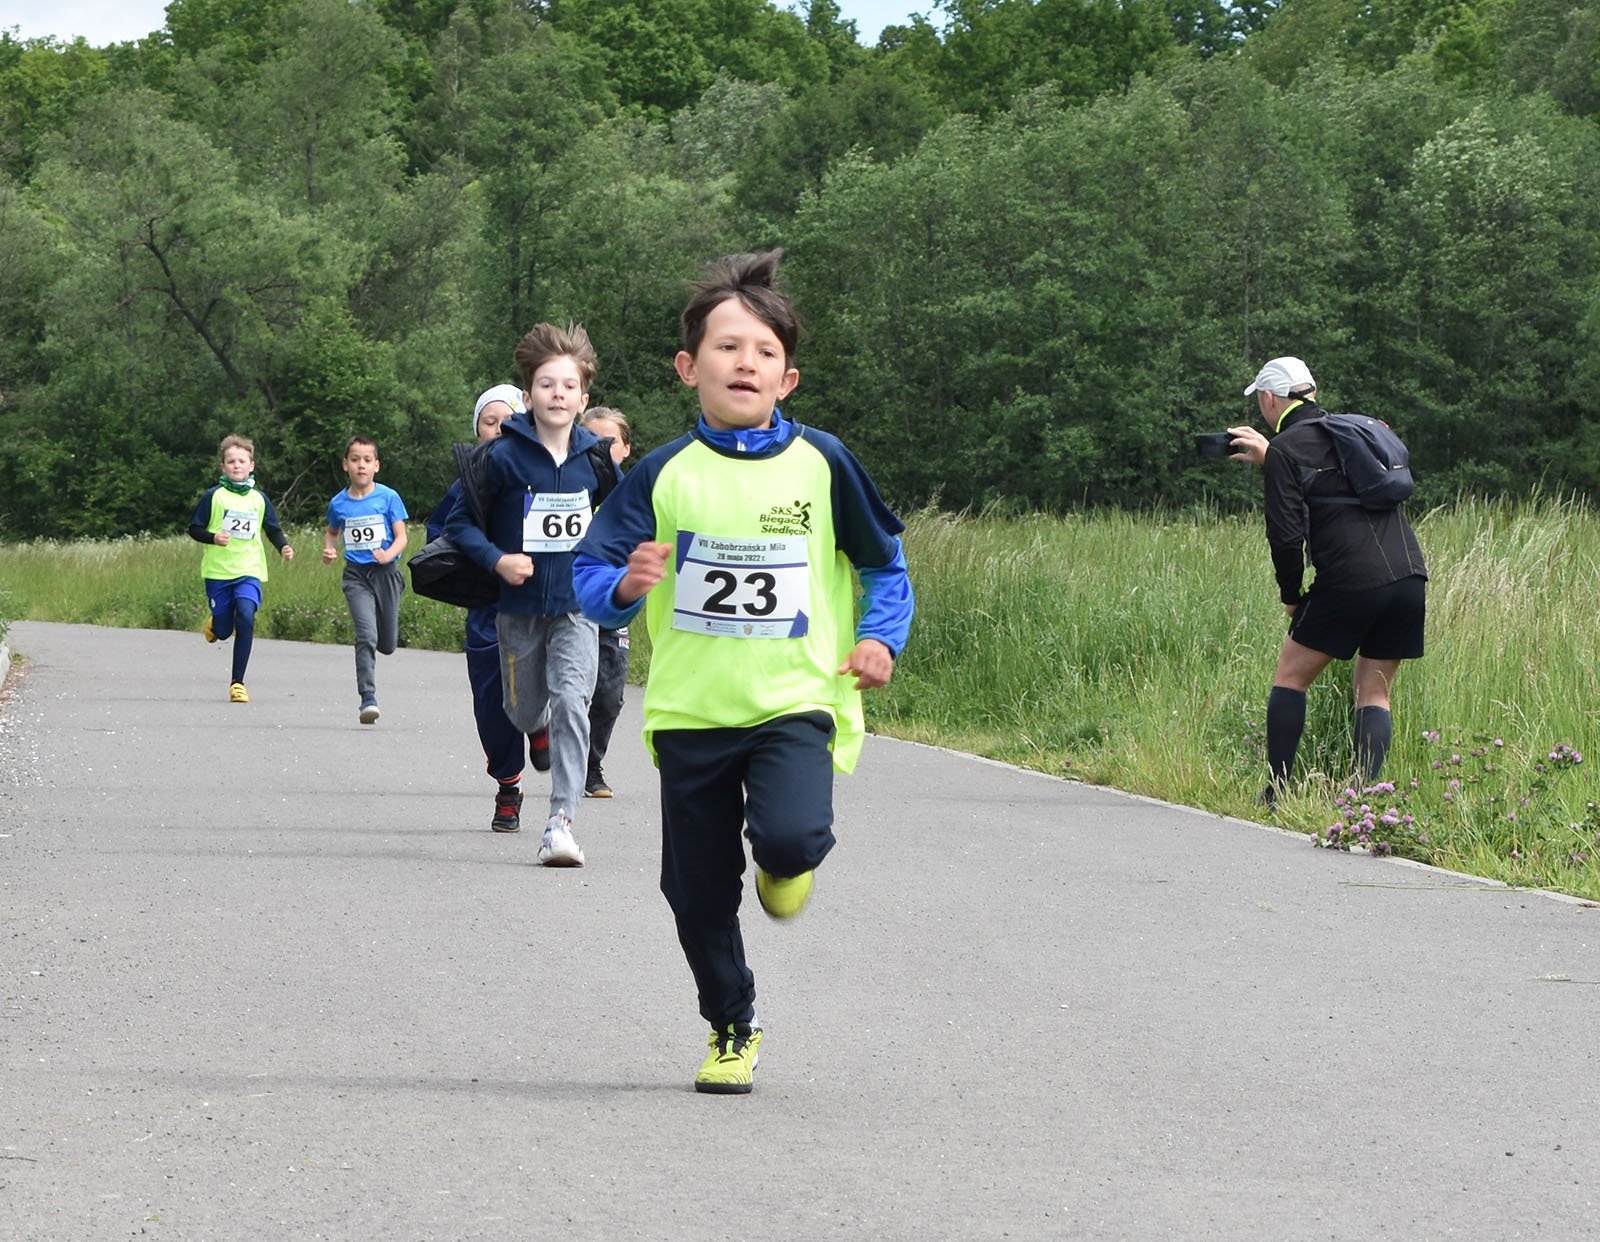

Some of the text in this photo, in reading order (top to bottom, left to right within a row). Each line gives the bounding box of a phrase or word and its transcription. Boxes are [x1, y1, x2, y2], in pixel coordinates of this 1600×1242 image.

[770, 506, 792, 516] SKS
[231, 519, 251, 532] 24
[542, 513, 582, 538] 66
[759, 513, 801, 526] Biegacz
[351, 527, 374, 543] 99
[698, 538, 787, 552] VII Zabobrzańska Mila
[702, 569, 778, 617] 23
